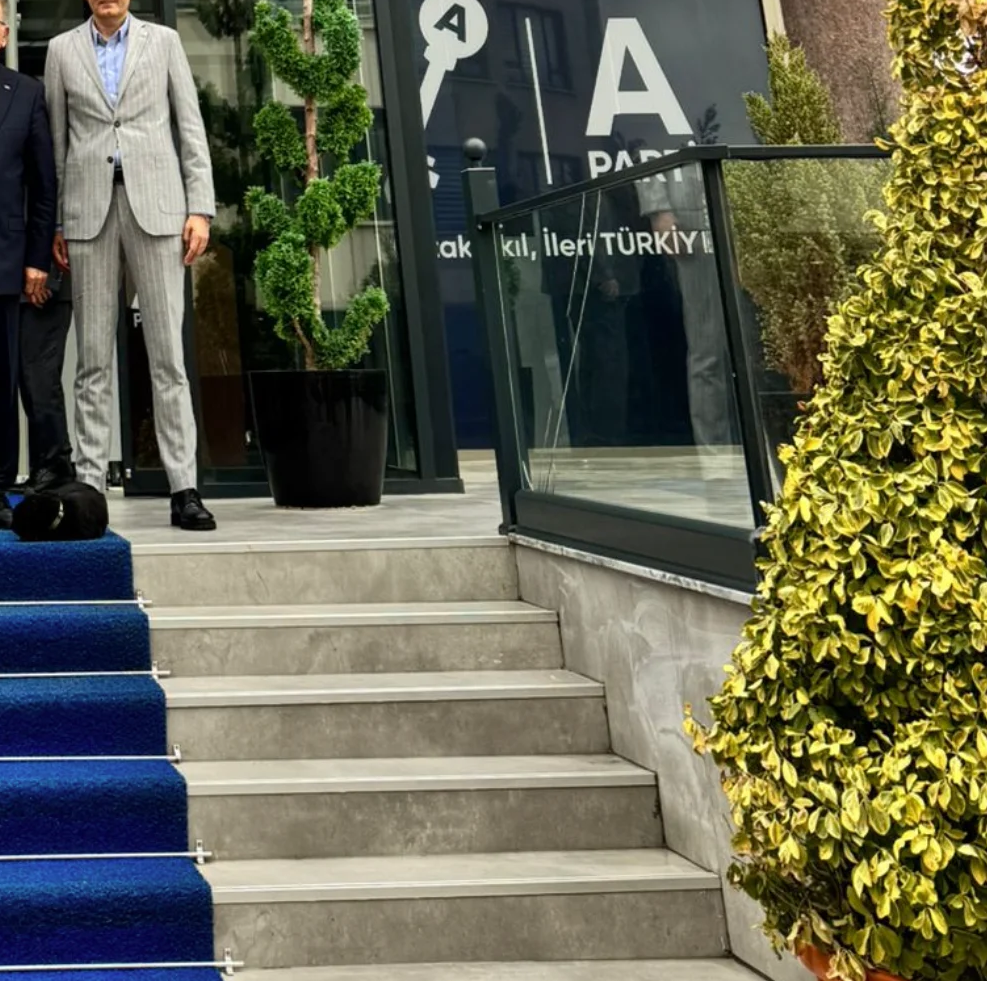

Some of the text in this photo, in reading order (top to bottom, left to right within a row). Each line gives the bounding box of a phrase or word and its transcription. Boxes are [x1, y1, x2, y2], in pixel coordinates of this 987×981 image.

[585, 17, 694, 136] A
[435, 234, 473, 259] ak
[499, 233, 537, 261] kıl,
